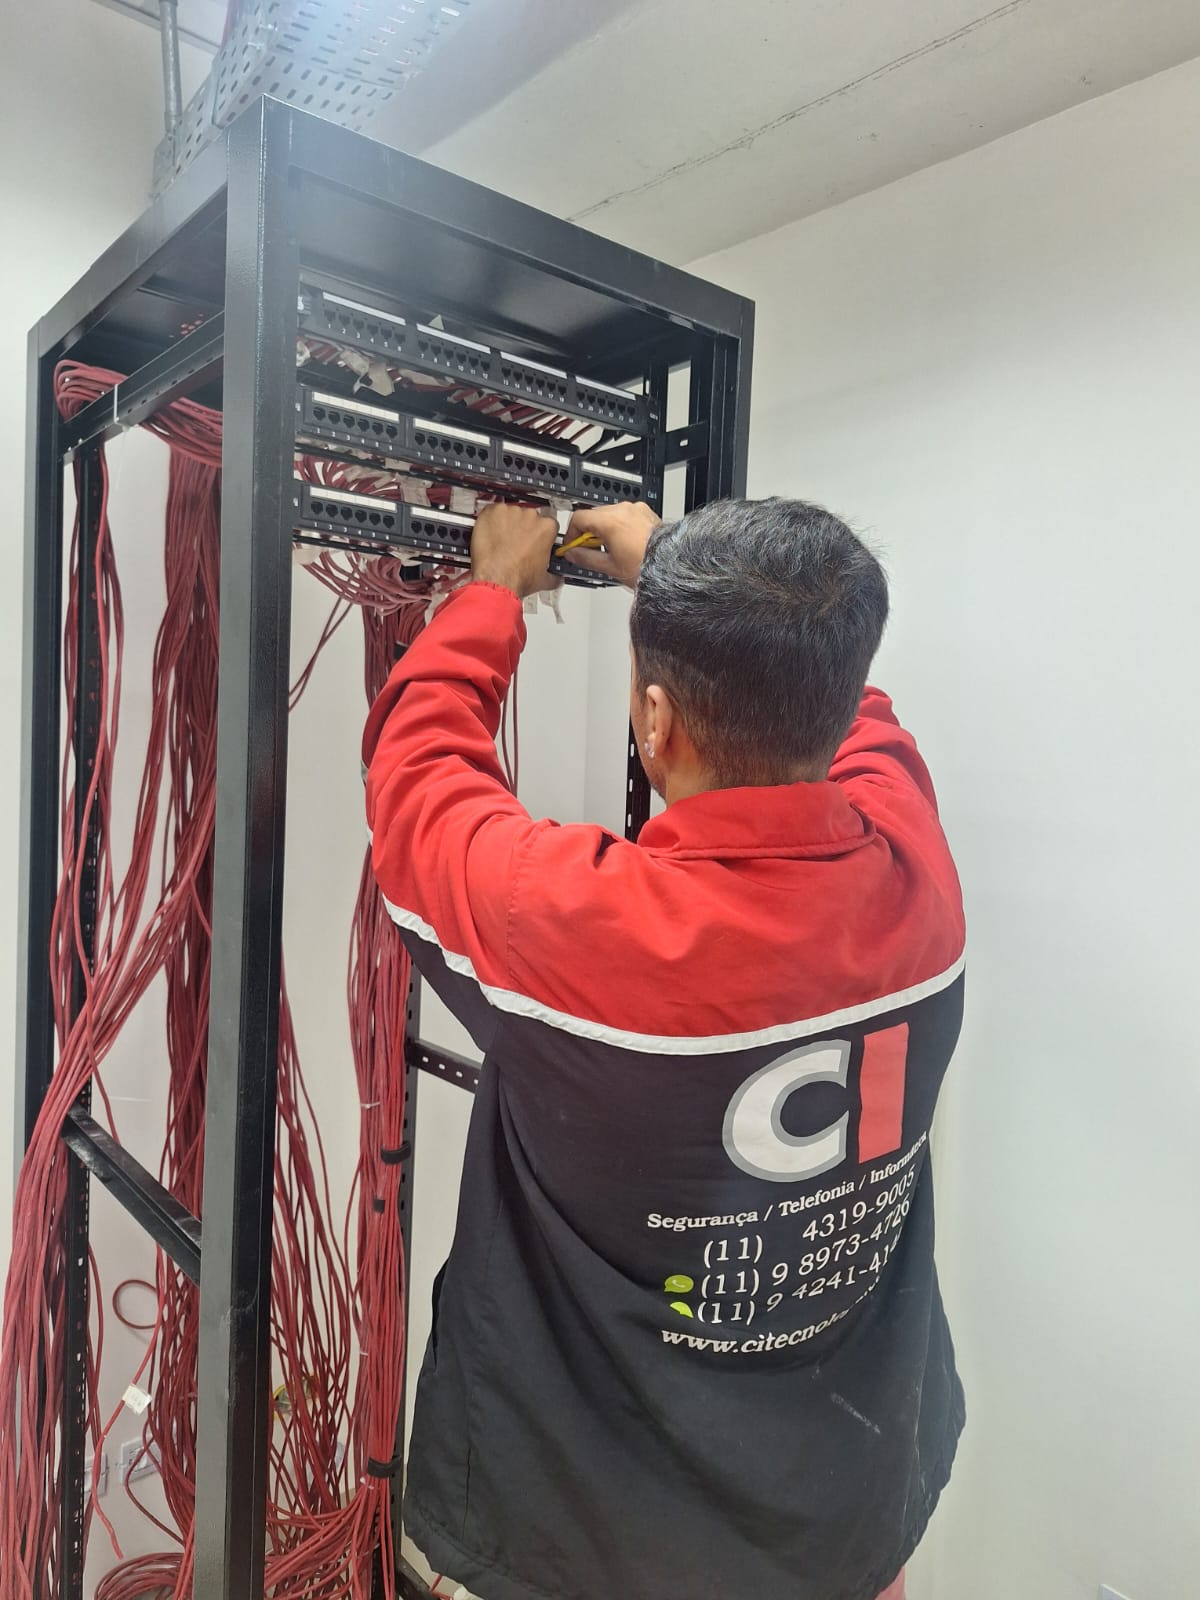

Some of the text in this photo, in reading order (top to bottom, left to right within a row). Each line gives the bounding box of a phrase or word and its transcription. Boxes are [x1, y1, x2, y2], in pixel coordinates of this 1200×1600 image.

[647, 1209, 759, 1232] Segurança
[763, 1204, 775, 1222] /
[778, 1181, 856, 1217] Telefonia
[703, 1164, 916, 1269] (11) 4319-9005
[700, 1193, 910, 1299] (11) 9 8973-4726
[697, 1300, 756, 1326] (11)
[766, 1293, 783, 1313] 9
